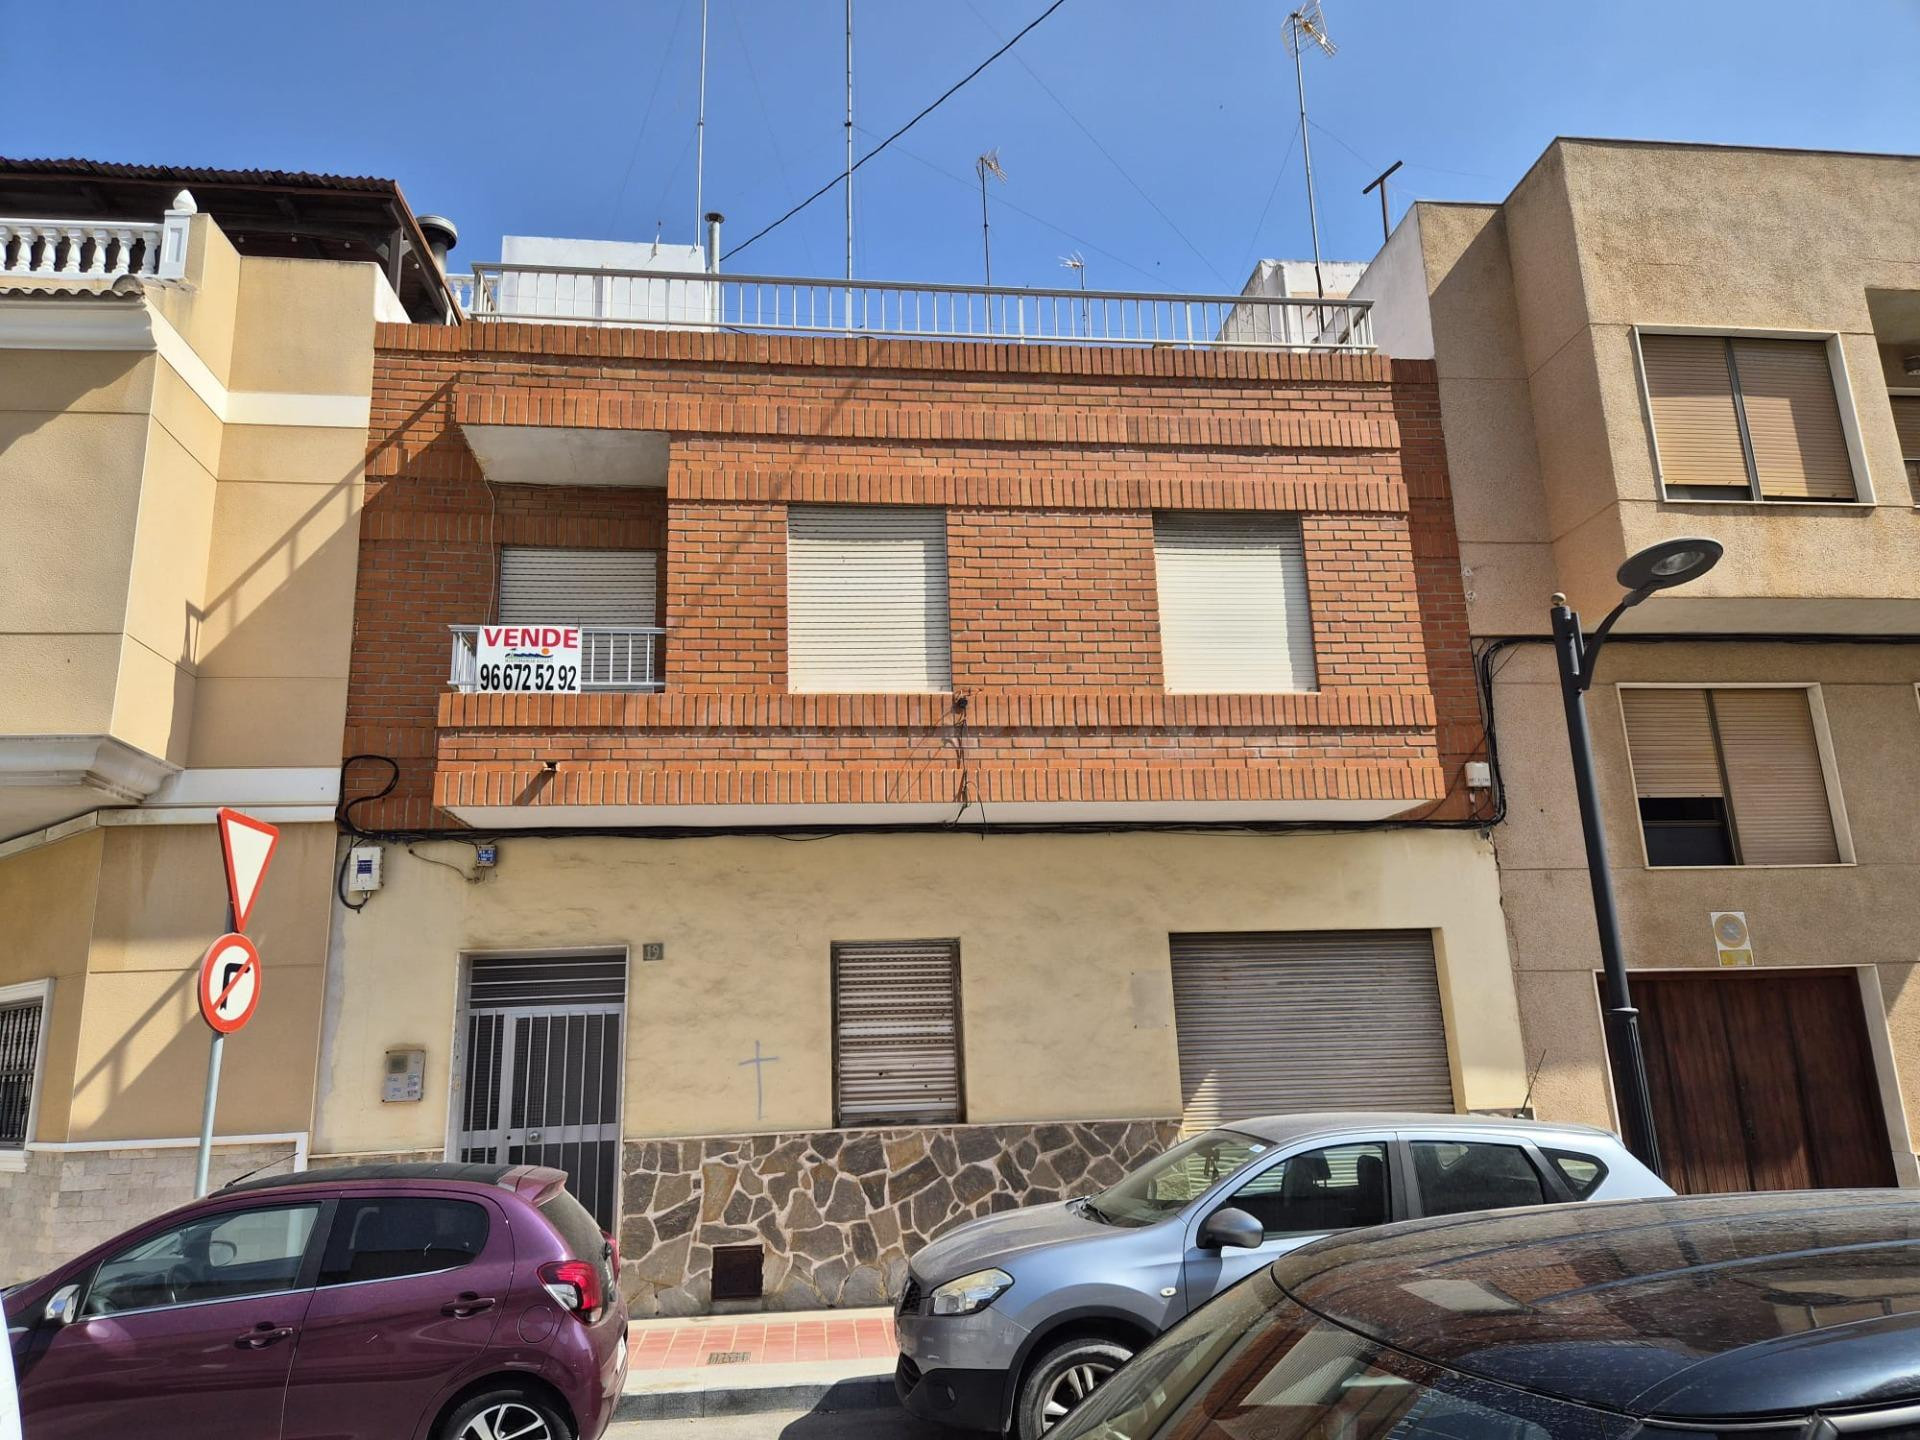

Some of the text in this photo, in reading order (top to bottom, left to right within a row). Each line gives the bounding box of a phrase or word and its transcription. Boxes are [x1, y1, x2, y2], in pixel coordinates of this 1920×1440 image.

[484, 628, 579, 649] VENDE
[480, 663, 577, 690] 96 672 52 92
[646, 945, 660, 960] 19
